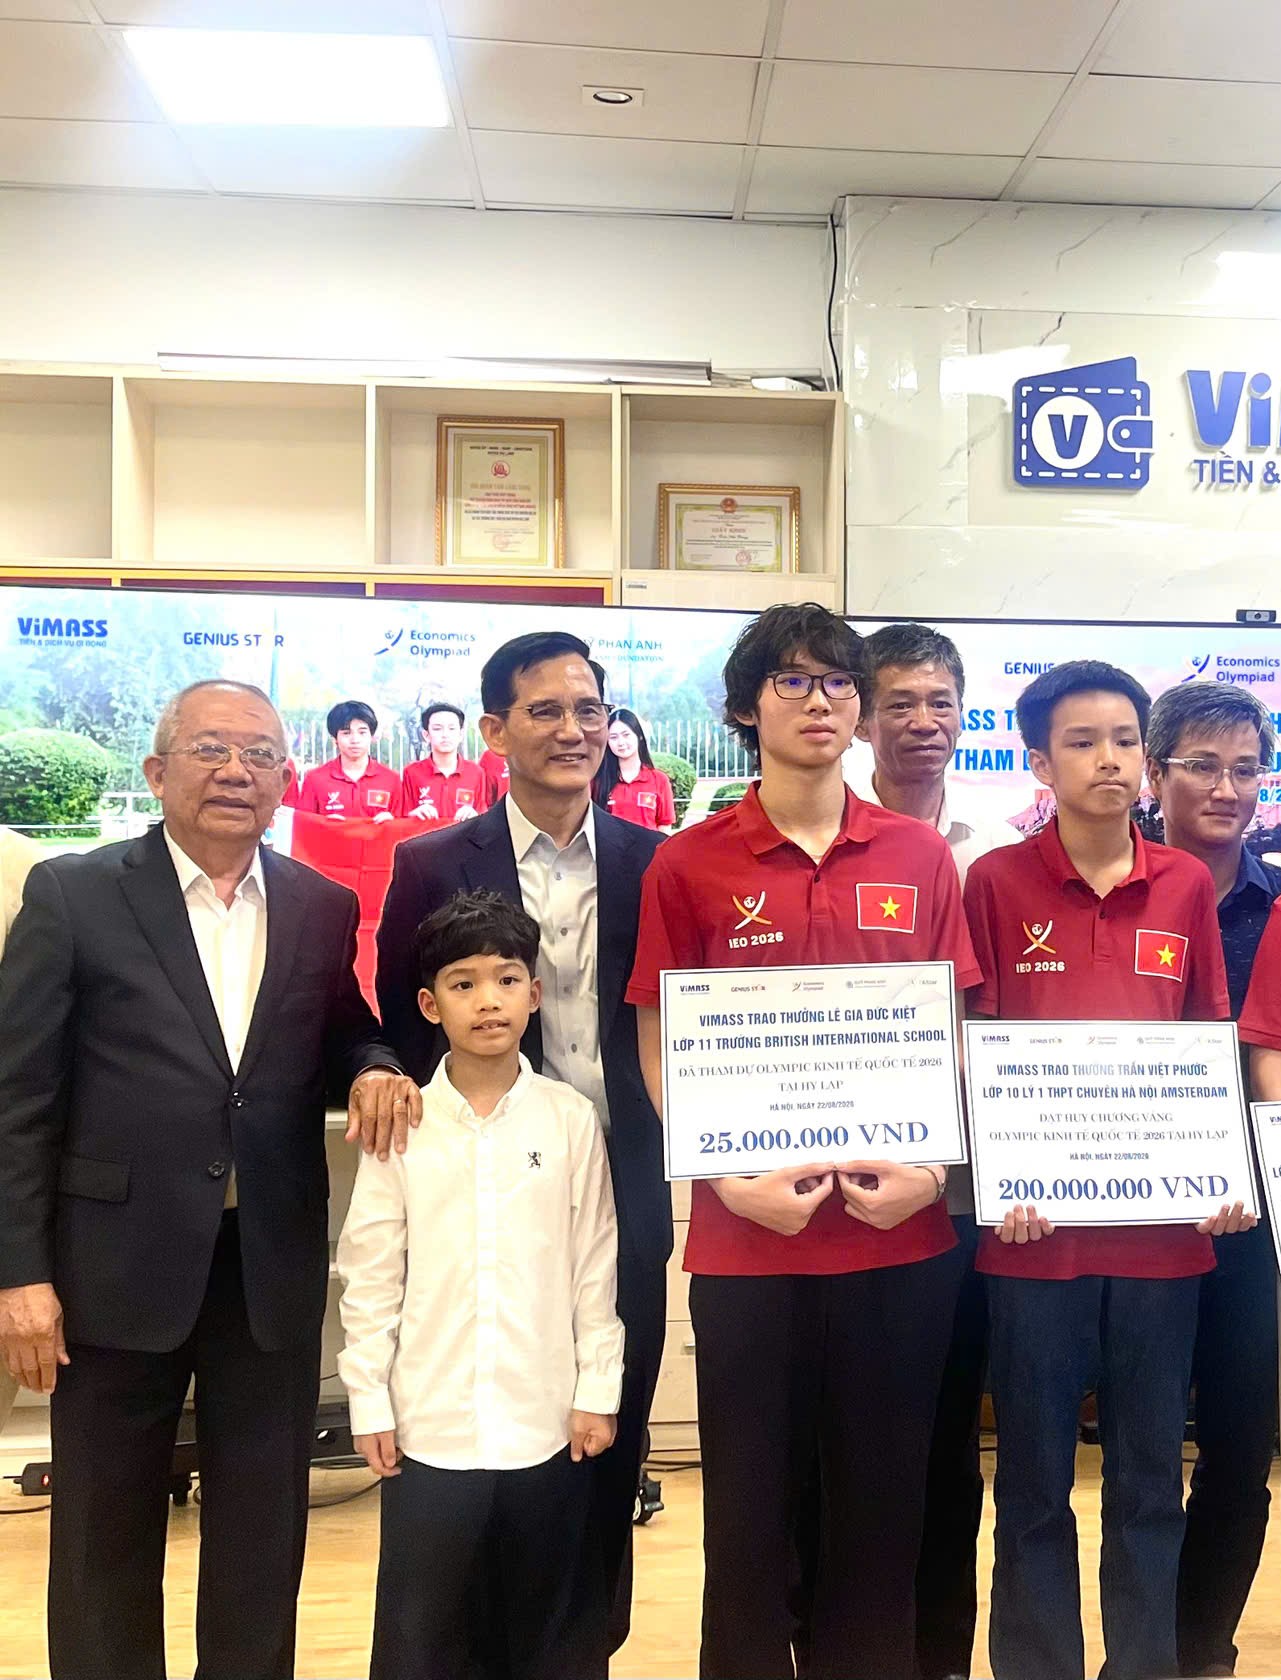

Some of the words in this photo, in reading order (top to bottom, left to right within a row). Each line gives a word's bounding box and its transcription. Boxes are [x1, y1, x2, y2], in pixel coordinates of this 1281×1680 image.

[1263, 462, 1280, 484] &
[183, 632, 239, 646] GENIUS
[410, 629, 476, 641] Economics
[410, 645, 470, 659] Olympiad
[636, 640, 662, 650] ANH
[1216, 656, 1280, 668] Economics
[1216, 671, 1275, 685] Olympiad
[955, 749, 1014, 770] THAM
[729, 938, 748, 949] IEO
[751, 932, 784, 946] 2026
[1016, 962, 1031, 973] IEO
[1034, 961, 1065, 973] 2026
[700, 1014, 743, 1026] VIMASS
[748, 1013, 776, 1024] TRAO
[828, 1008, 841, 1022] LÊ
[845, 1009, 863, 1021] GIA
[867, 1008, 888, 1020] ĐỨC
[893, 1006, 916, 1021] KIỆT
[674, 1039, 694, 1051] LỚP
[699, 1039, 711, 1050] 11
[716, 1036, 761, 1049] TRƯỜNG
[765, 1035, 808, 1047] BRITISH
[813, 1032, 899, 1045] INTERNATIONAL
[904, 1030, 946, 1042] SCHOOL
[983, 1086, 1002, 1098] LỚP
[1007, 1087, 1019, 1098] 10
[1022, 1087, 1034, 1098] LÝ
[1039, 1088, 1043, 1098] 1
[1047, 1087, 1073, 1098] THPT
[1077, 1085, 1118, 1098] CHUYÊN
[1122, 1085, 1135, 1098] HÀ
[1139, 1085, 1158, 1098] NỘI
[1161, 1087, 1228, 1098] AMSTERDAM
[700, 1126, 849, 1153] 25.000.000
[857, 1122, 929, 1144] VND
[999, 1178, 1152, 1200] 200.000.000
[1160, 1176, 1229, 1198] VND
